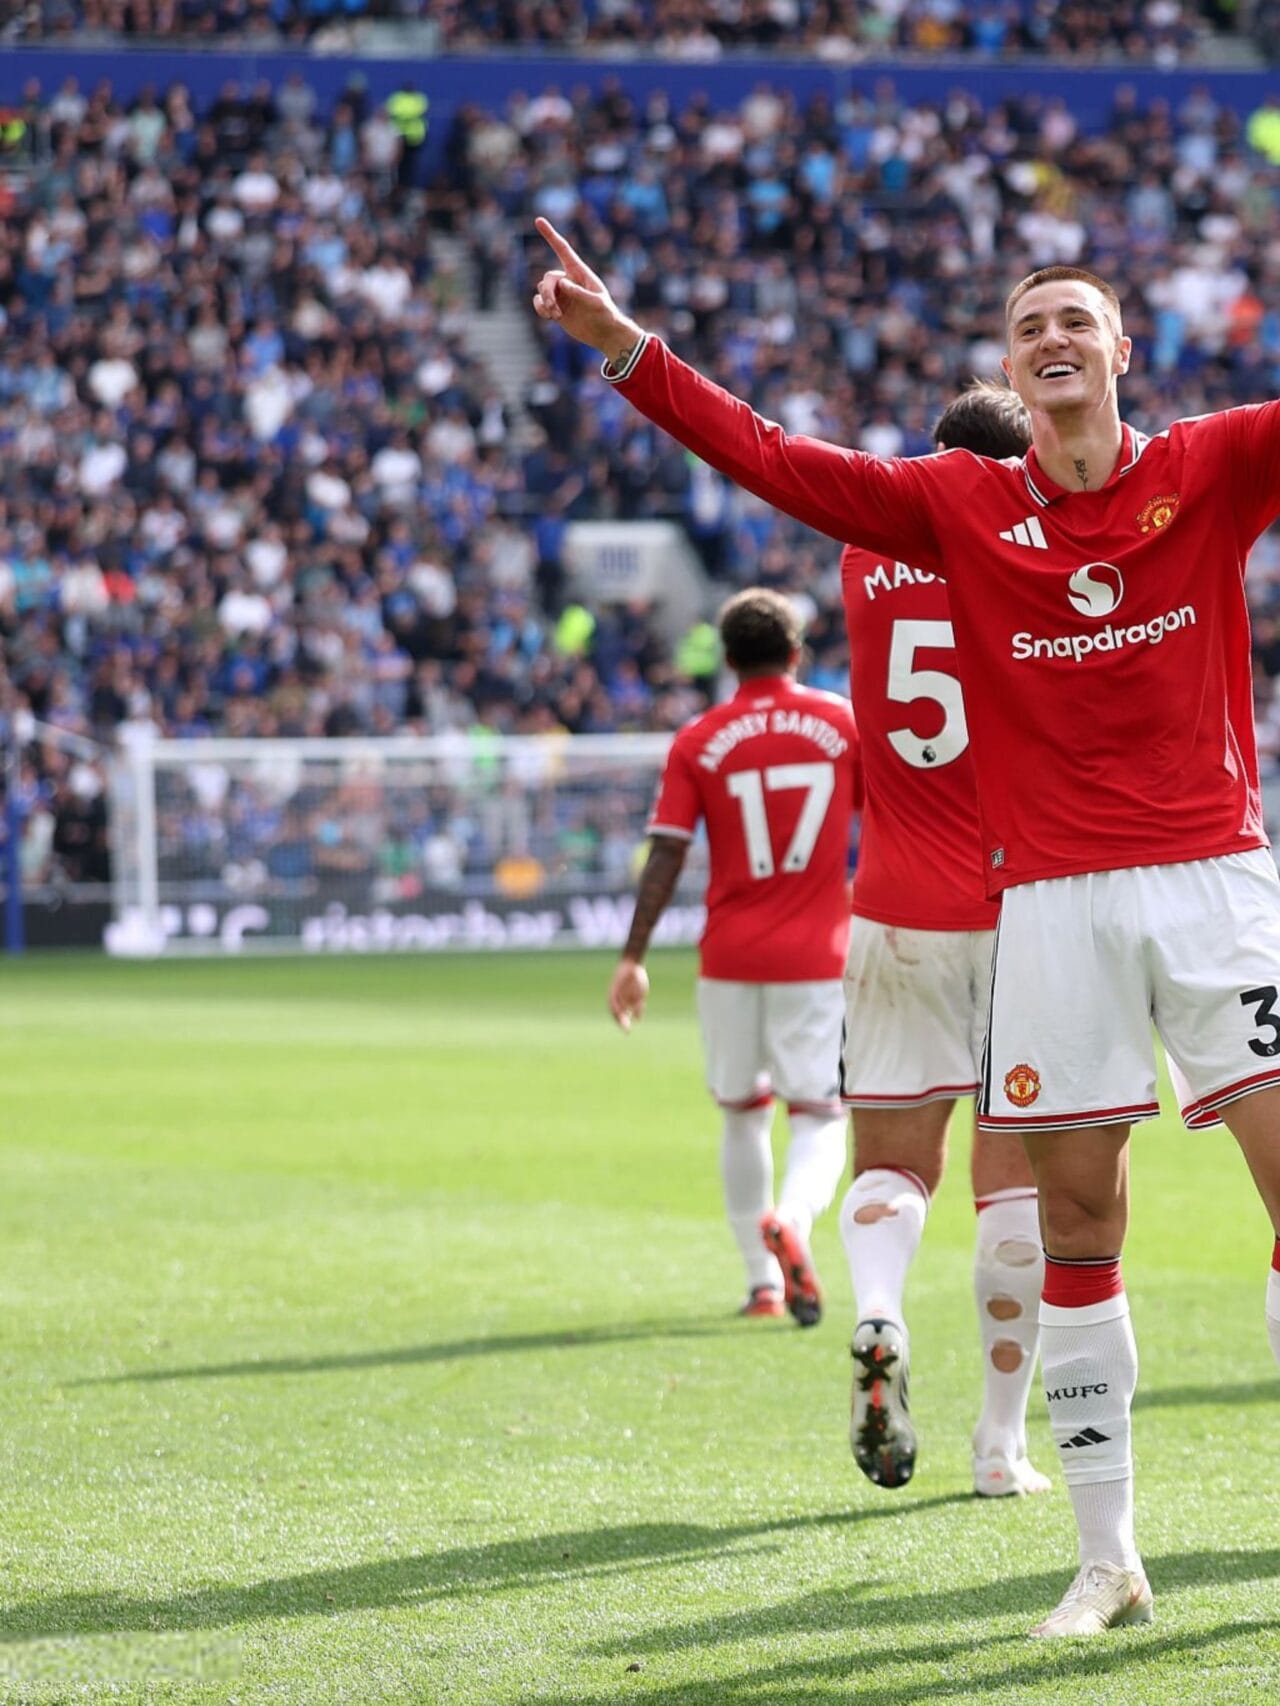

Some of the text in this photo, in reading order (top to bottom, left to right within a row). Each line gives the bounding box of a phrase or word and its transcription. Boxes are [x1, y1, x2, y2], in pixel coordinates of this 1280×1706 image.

[1011, 605, 1197, 662] Snapdragon
[886, 619, 970, 769] 5
[726, 760, 836, 880] 17
[1046, 1382, 1109, 1402] MUFC
